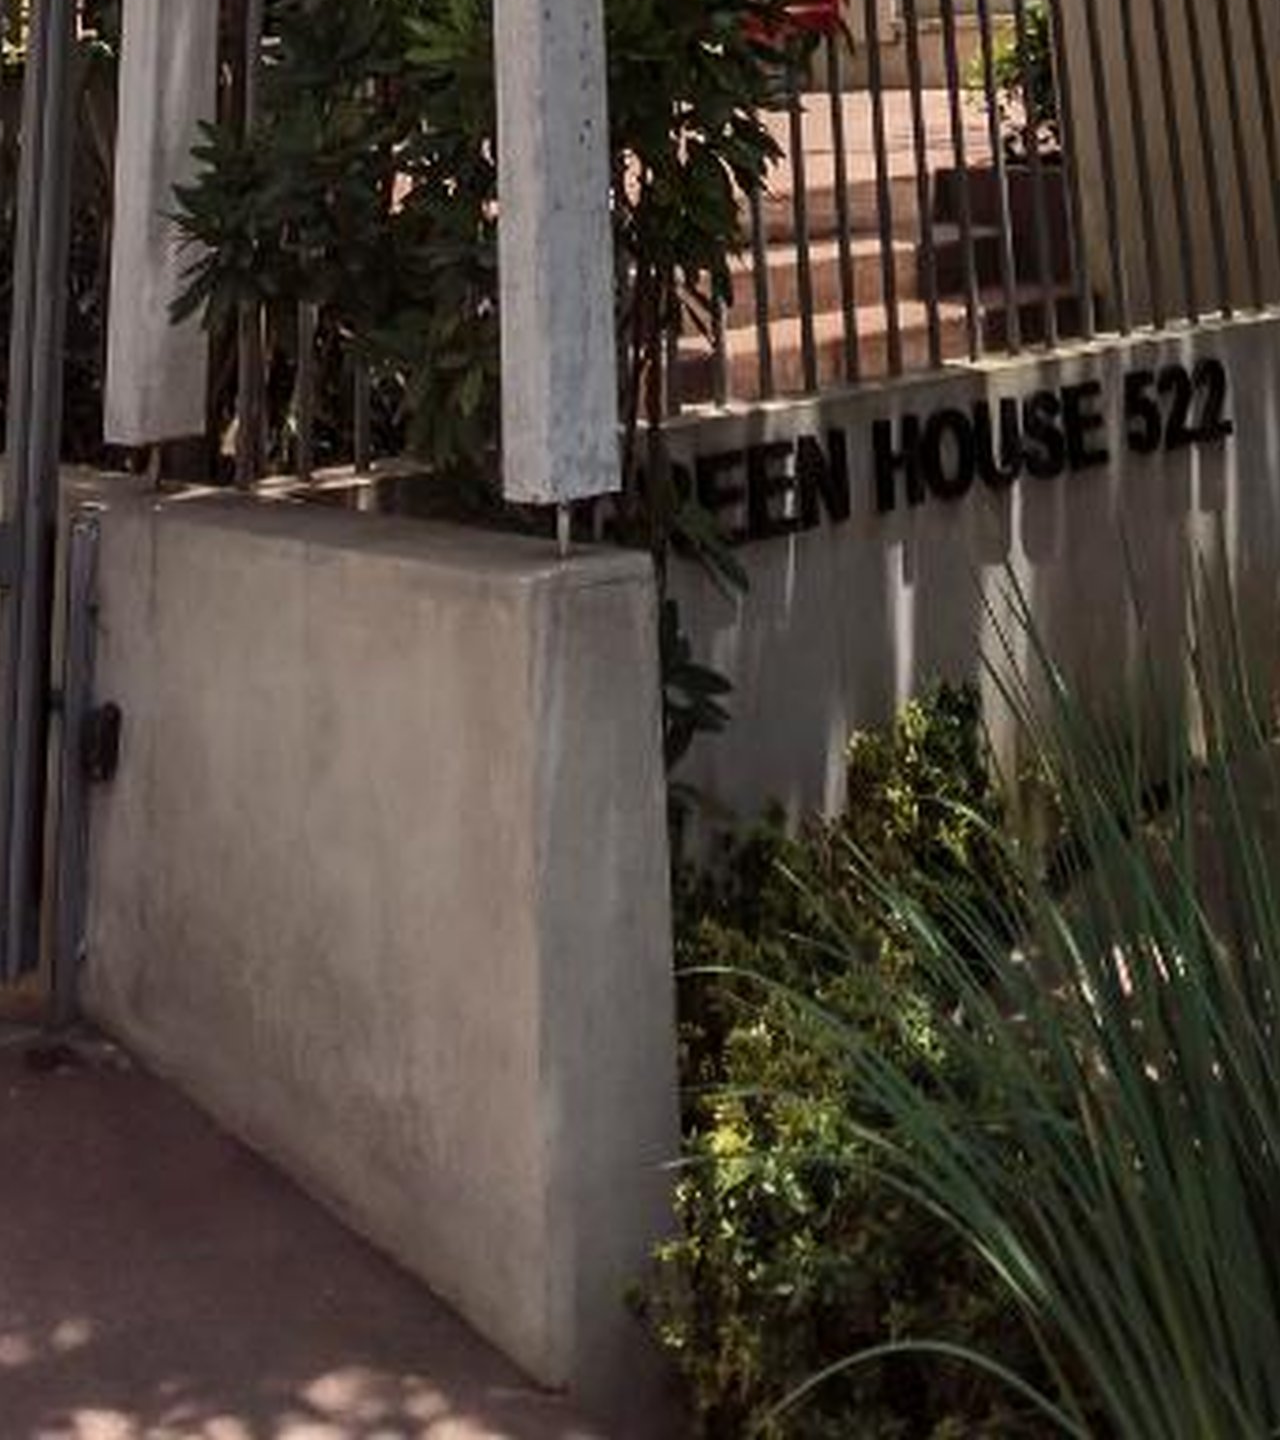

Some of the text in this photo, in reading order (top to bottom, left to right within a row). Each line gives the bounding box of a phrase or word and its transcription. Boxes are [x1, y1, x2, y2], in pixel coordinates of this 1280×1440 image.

[670, 358, 1233, 544] EEN HOUSE 522
